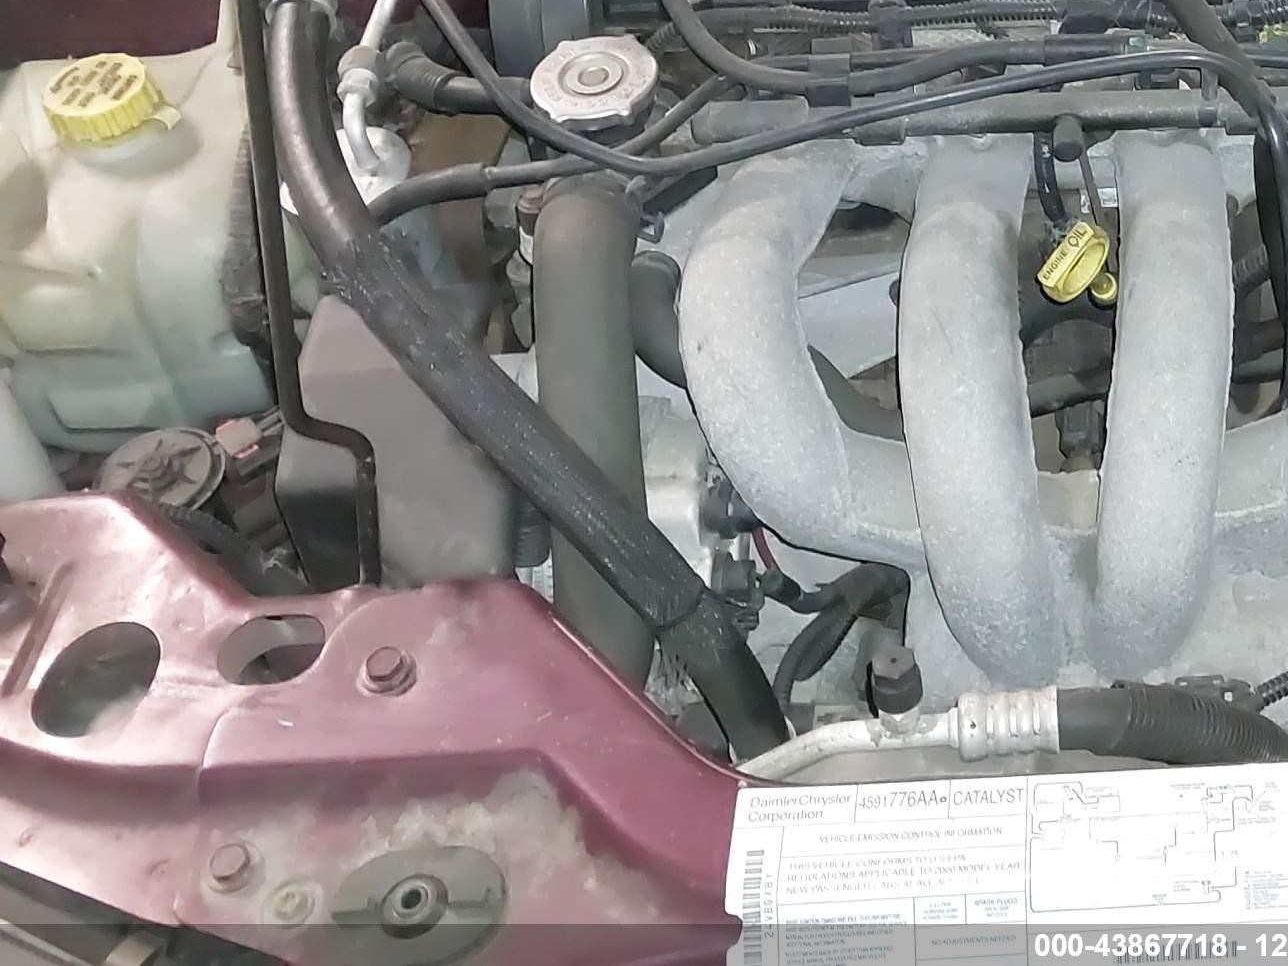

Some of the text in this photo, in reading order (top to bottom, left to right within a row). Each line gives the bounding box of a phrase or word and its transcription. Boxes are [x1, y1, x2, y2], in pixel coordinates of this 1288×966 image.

[1042, 229, 1088, 281] ENGINE OIL
[953, 788, 1024, 806] CATALYST
[748, 809, 823, 823] Corporation
[944, 827, 1002, 838] INFORMATION
